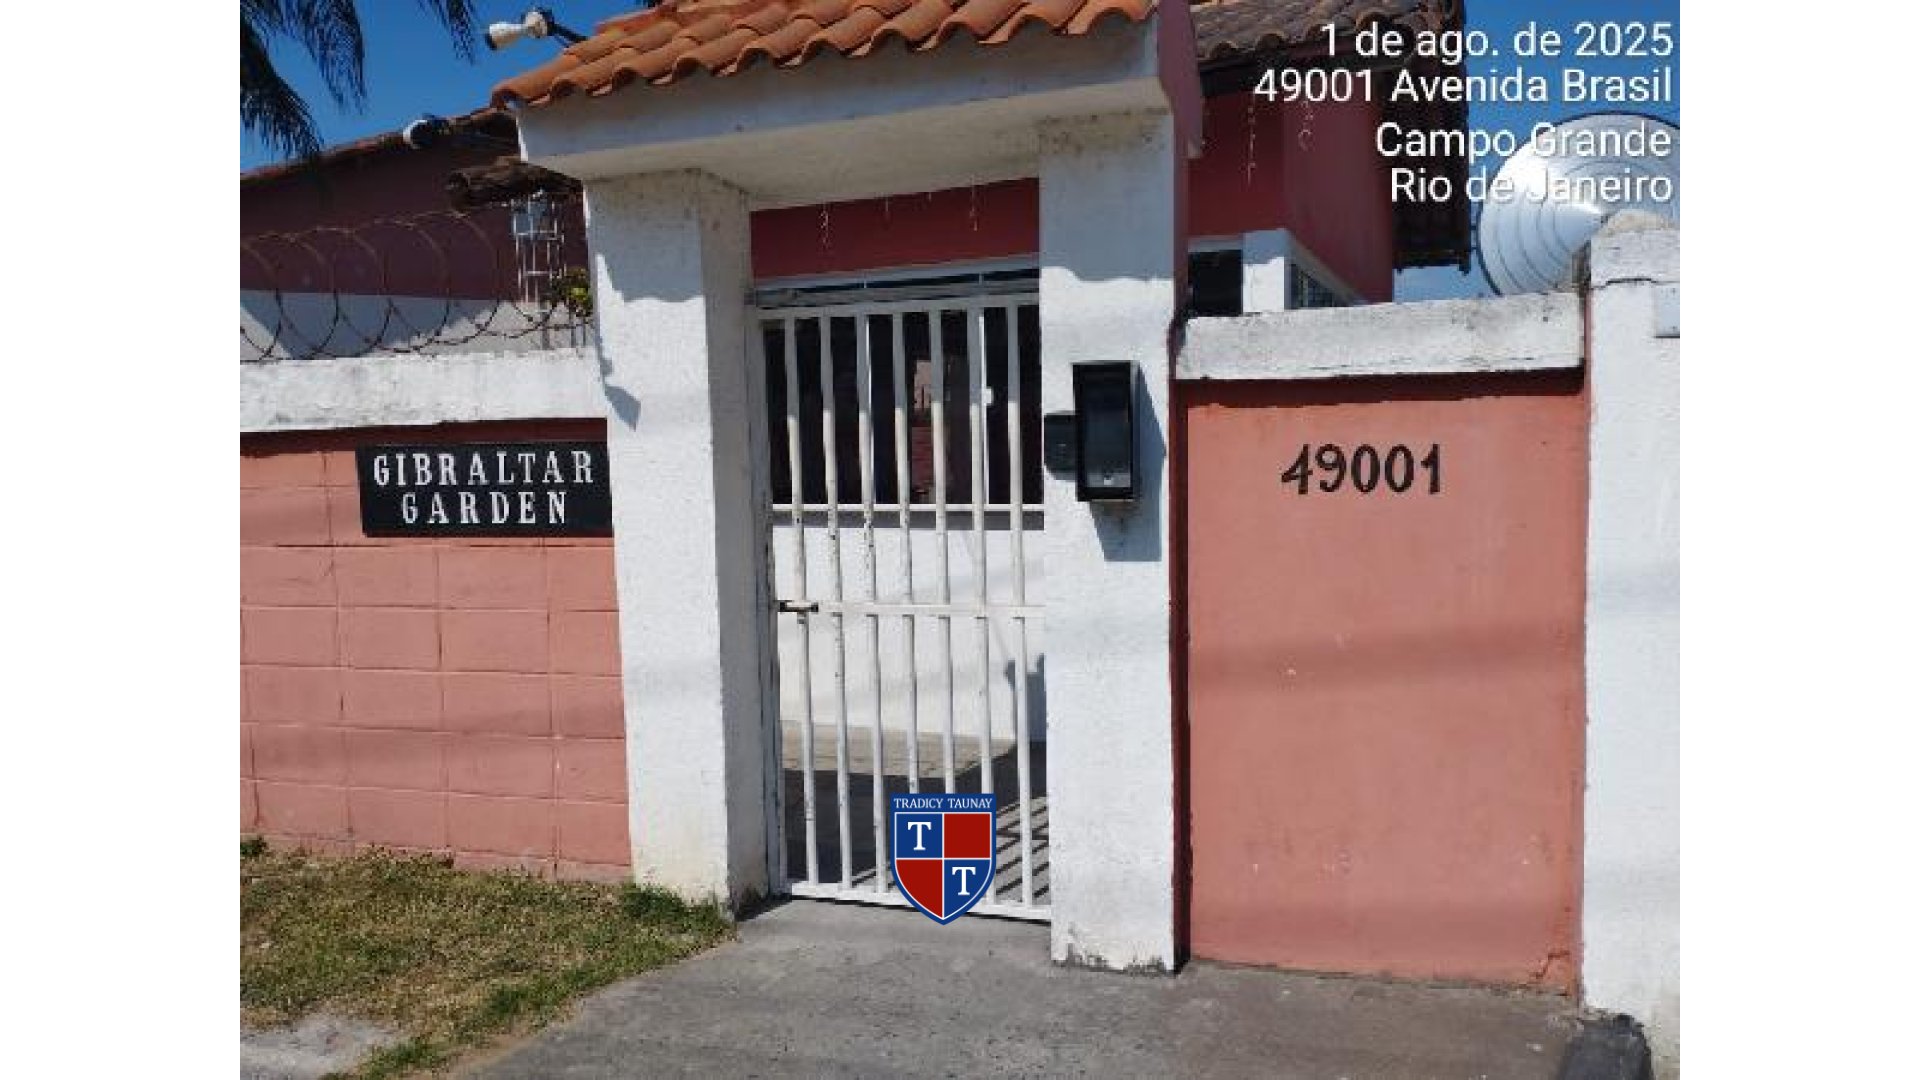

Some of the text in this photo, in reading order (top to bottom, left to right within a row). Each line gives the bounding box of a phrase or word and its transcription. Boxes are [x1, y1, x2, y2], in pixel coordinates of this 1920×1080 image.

[373, 450, 594, 487] GIBRALTAR
[1280, 443, 1441, 495] 49001
[402, 491, 567, 524] GARDEN
